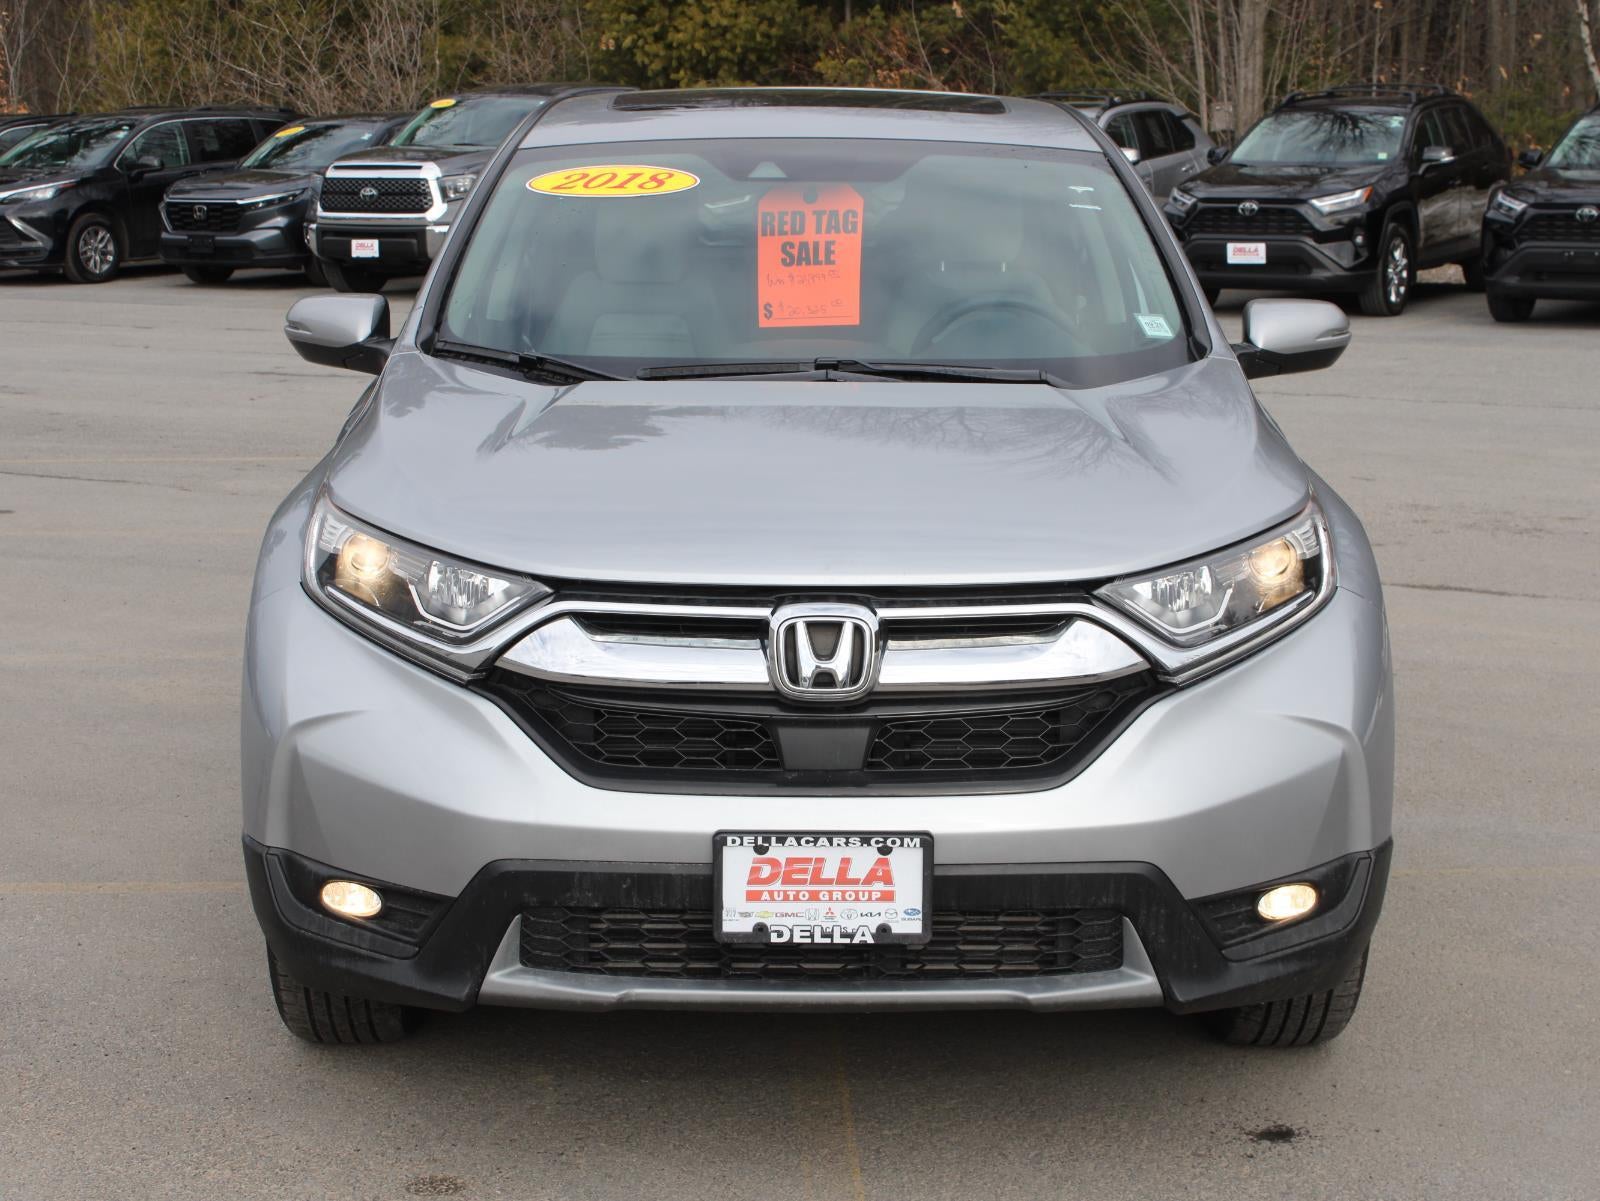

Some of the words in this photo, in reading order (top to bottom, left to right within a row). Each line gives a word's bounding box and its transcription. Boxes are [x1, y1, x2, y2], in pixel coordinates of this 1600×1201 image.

[550, 172, 675, 190] 2018
[761, 211, 806, 237] RED
[812, 209, 859, 235] TAG
[781, 240, 837, 267] SALE
[763, 303, 773, 320] $
[726, 836, 921, 848] DELLACARS.COM
[746, 857, 895, 886] DELLA
[761, 891, 809, 901] AUTO
[819, 891, 882, 901] GROUP
[770, 924, 875, 944] DELLA
